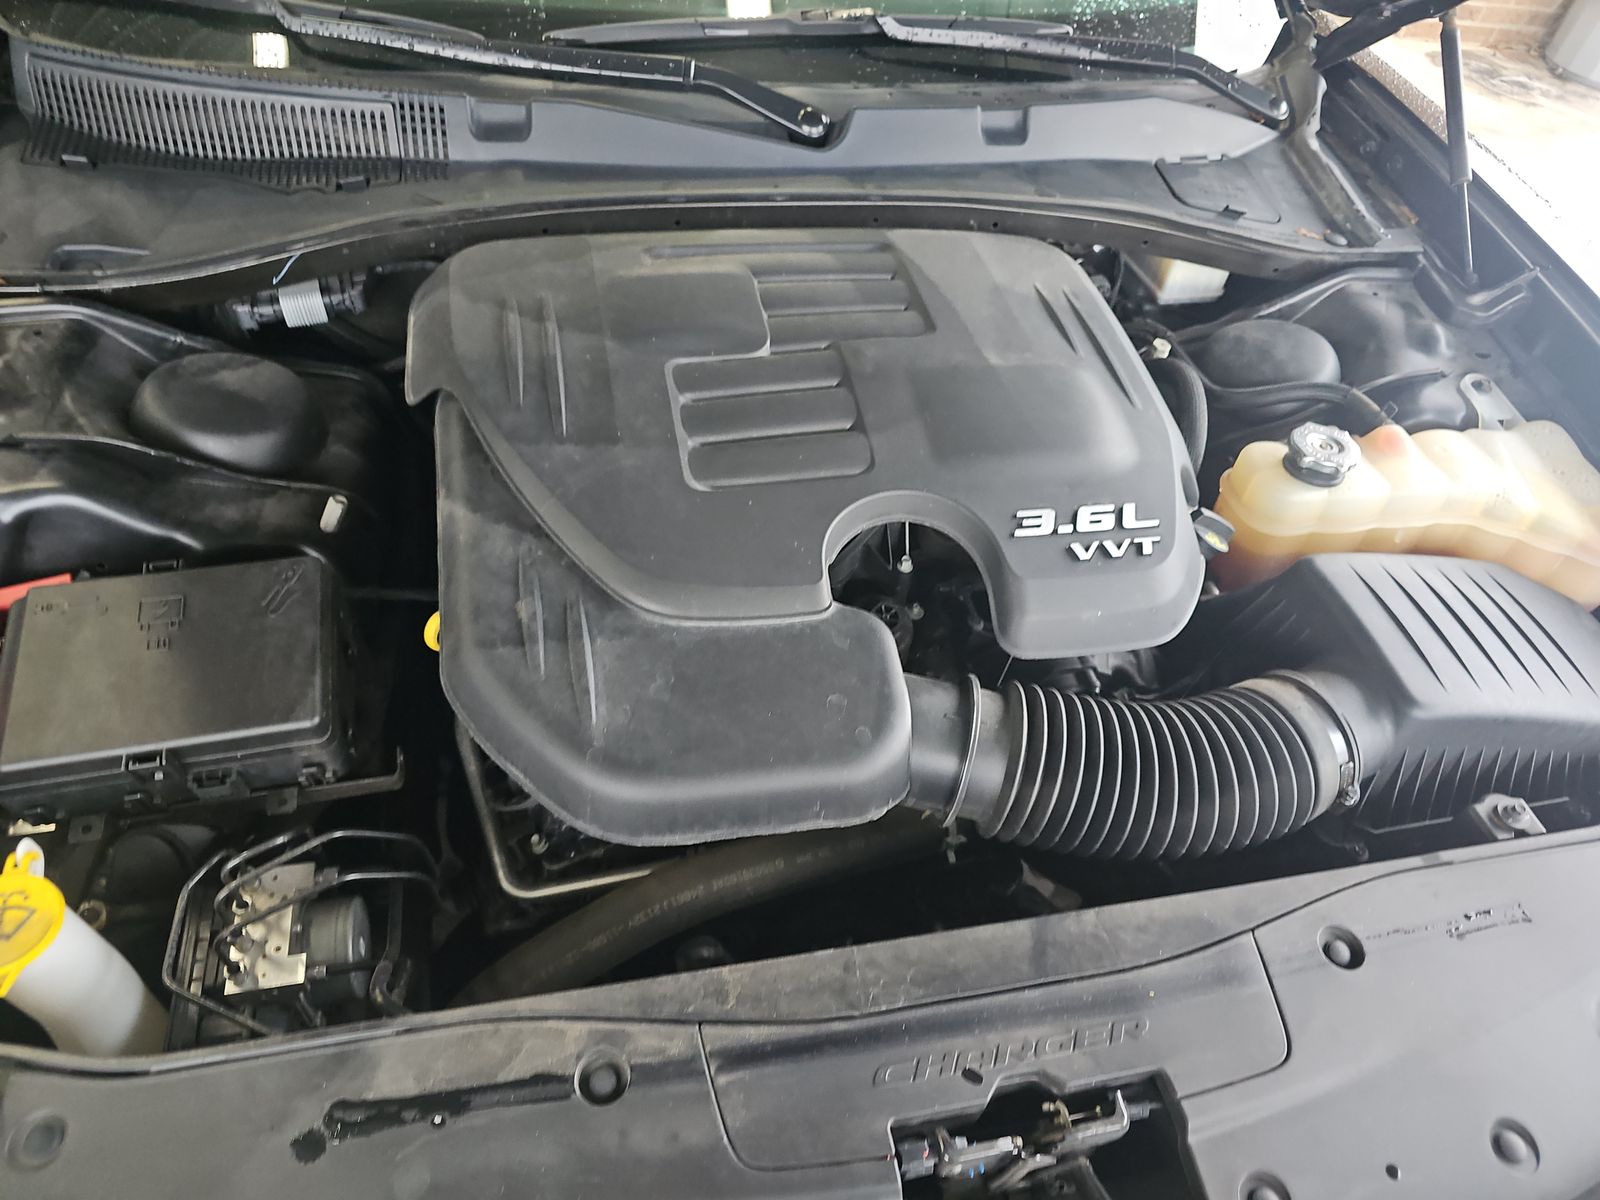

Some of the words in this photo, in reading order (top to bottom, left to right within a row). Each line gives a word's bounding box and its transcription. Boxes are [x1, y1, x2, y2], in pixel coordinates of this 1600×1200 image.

[1012, 501, 1161, 538] 3.6L
[1067, 535, 1161, 562] VVT
[872, 1018, 1150, 1088] CHARGER
